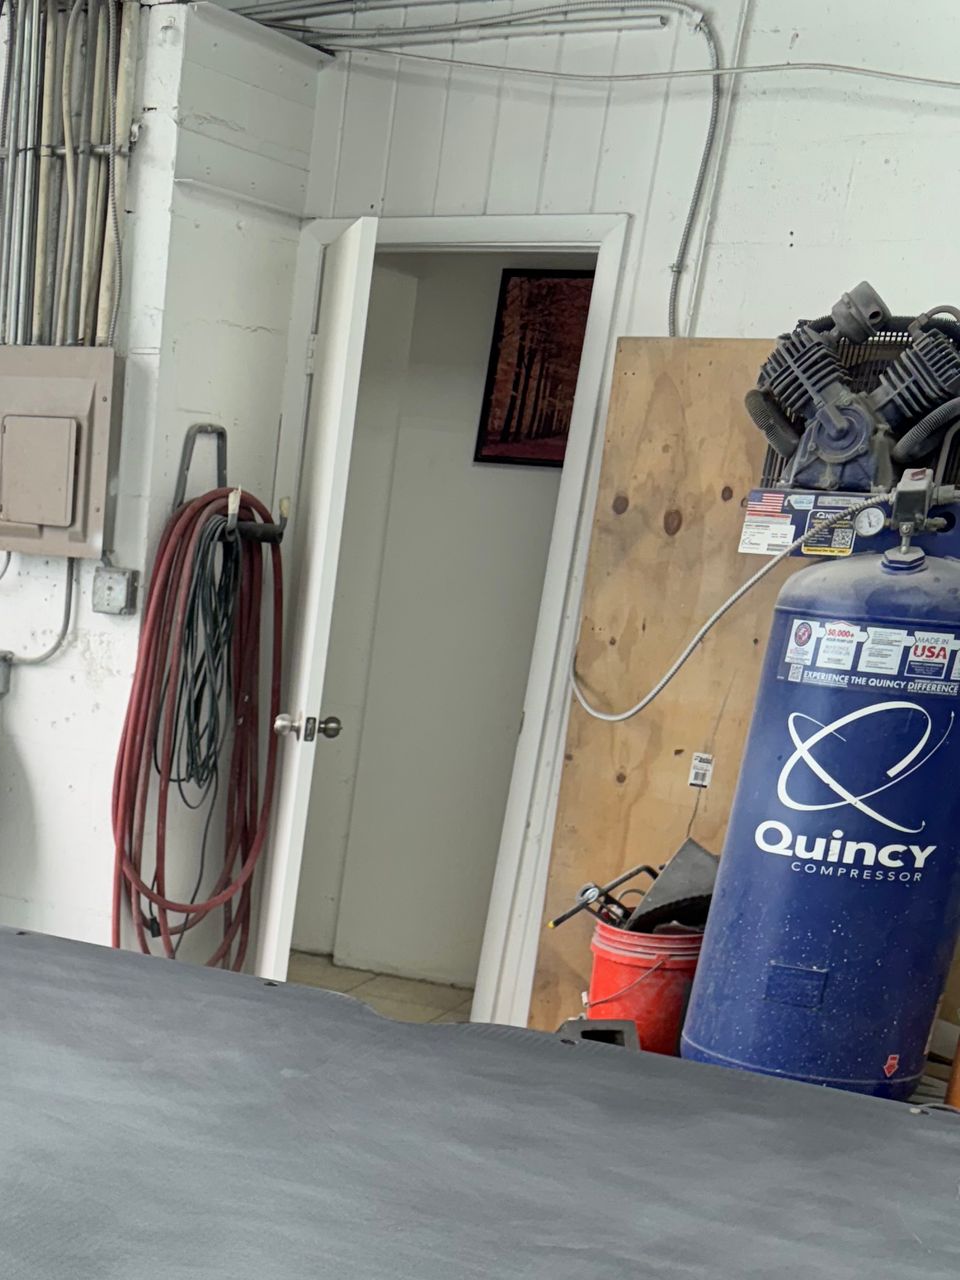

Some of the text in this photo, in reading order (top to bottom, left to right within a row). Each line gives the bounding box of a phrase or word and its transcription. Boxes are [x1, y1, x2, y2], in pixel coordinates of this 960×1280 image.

[918, 636, 940, 645] MADE
[913, 645, 947, 660] USA
[803, 671, 850, 684] EXPERIENCE
[851, 676, 867, 685] THE
[868, 678, 907, 689] QUINCY
[908, 681, 959, 693] DIFFERENCE
[754, 820, 937, 868] Quincy
[791, 861, 923, 882] COMPRESSOR
